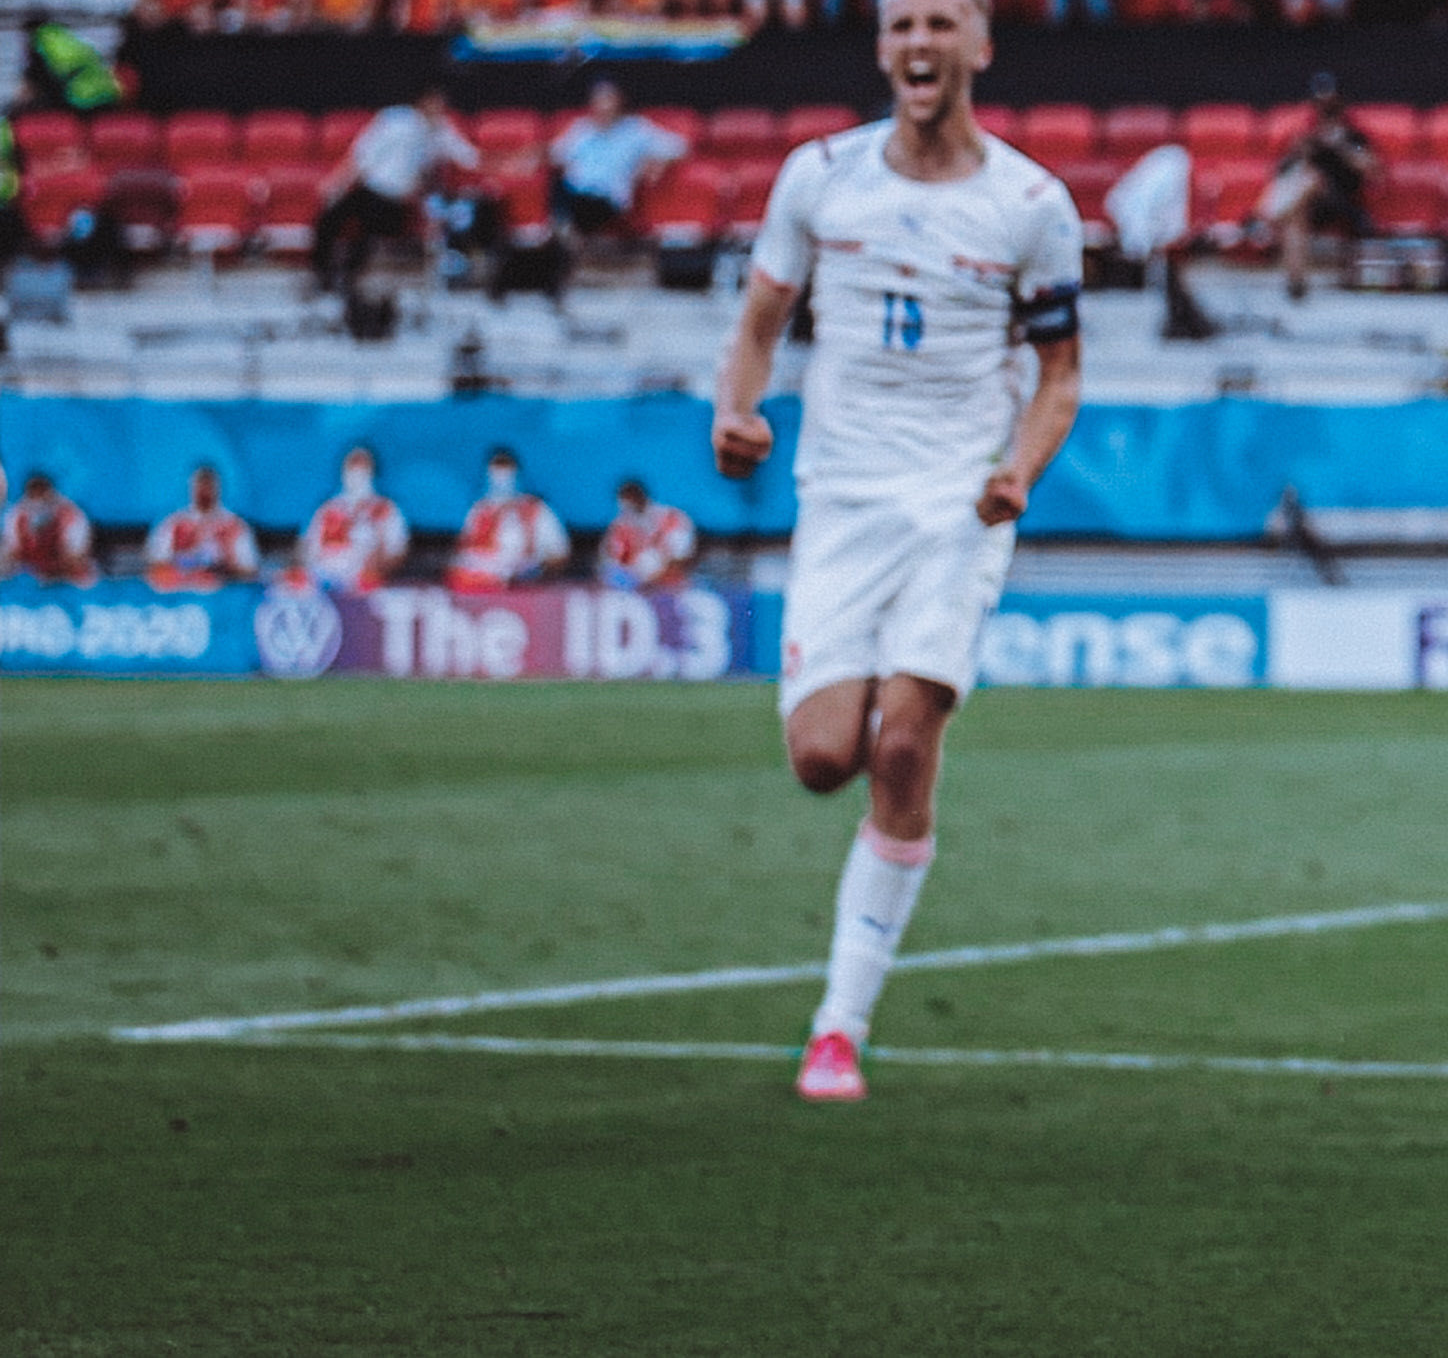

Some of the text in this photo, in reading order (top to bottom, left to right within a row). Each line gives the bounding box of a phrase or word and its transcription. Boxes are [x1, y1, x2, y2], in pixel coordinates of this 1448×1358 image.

[79, 603, 211, 660] 2020
[370, 587, 733, 680] The ID.3
